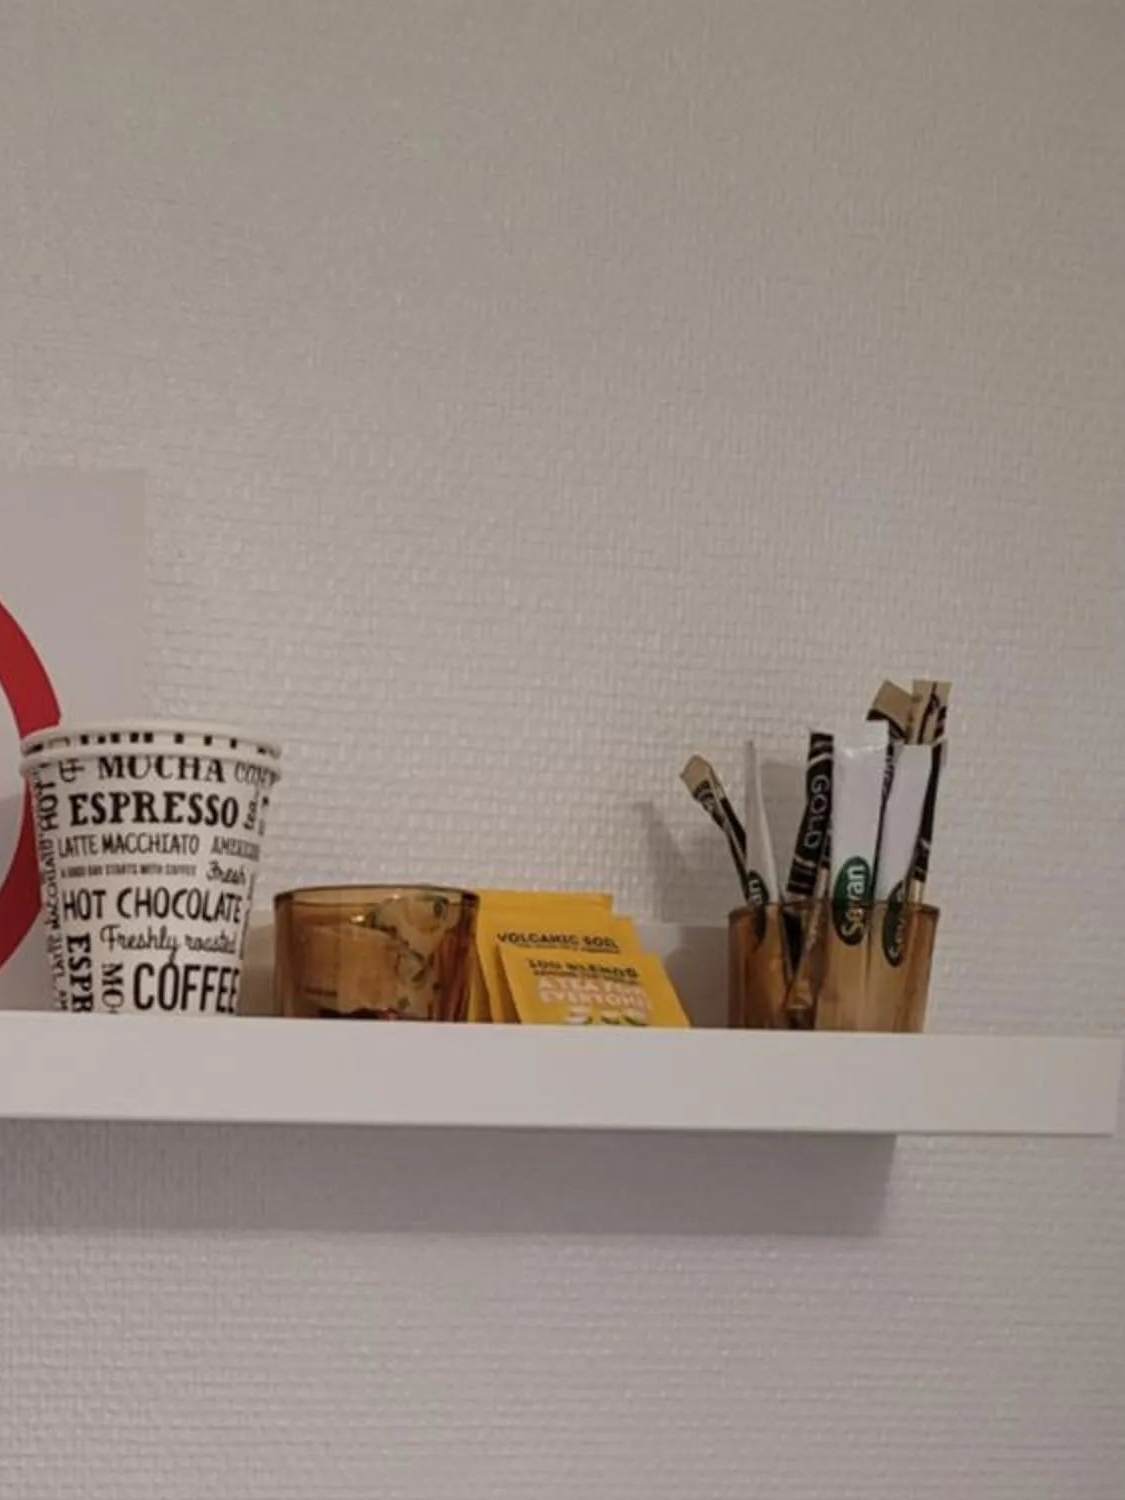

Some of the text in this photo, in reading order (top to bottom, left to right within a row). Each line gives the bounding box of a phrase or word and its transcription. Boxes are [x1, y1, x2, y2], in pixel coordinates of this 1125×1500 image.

[67, 790, 239, 829] ESPRESSO
[803, 773, 830, 850] GOLD
[58, 831, 201, 859] LATTE MACCHIATO
[62, 885, 244, 925] HOT CHOCOLATE
[99, 923, 181, 965] Freshly
[496, 931, 579, 946] VOLCANIC
[101, 963, 125, 1014] MO
[132, 962, 241, 1014] COFFEE
